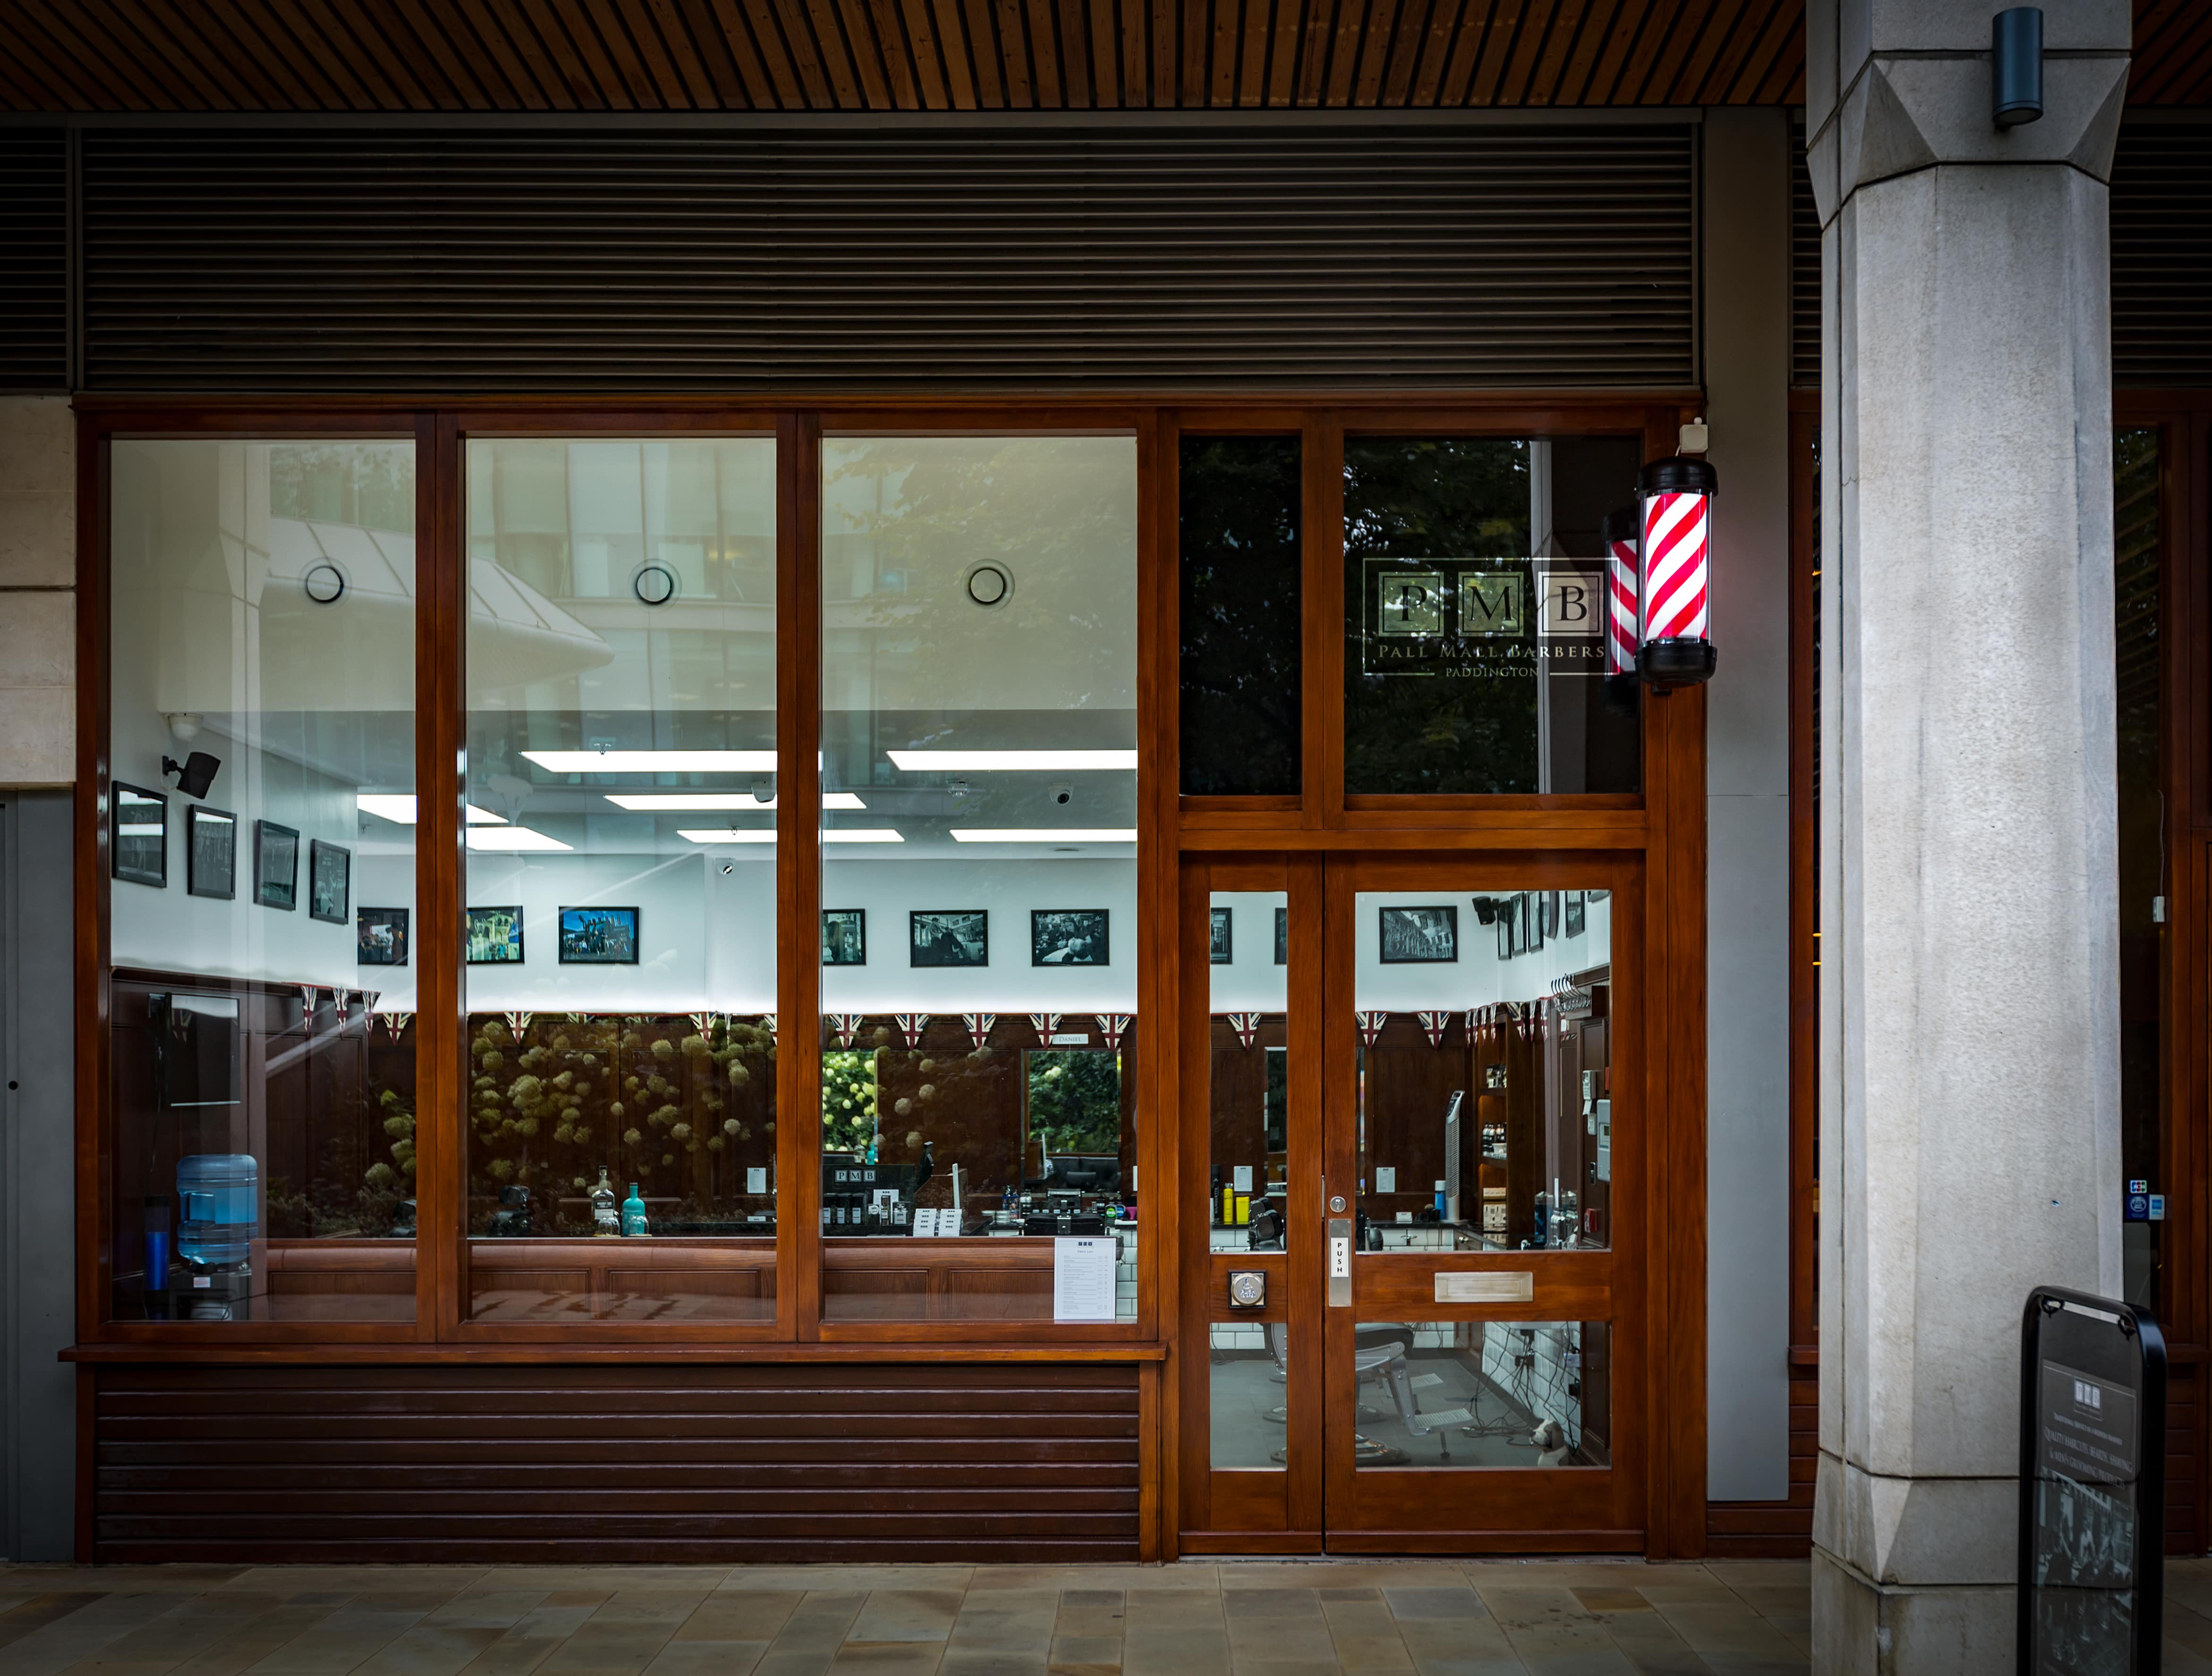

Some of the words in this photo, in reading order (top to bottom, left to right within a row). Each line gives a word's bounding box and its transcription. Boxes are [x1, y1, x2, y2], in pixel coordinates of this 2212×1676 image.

[1398, 585, 1427, 621] P
[1466, 585, 1513, 621] M
[1555, 585, 1587, 621] B
[1378, 645, 1428, 658] PALL
[1440, 644, 1497, 658] MALL
[1510, 645, 1604, 658] BARBERS
[1446, 667, 1539, 677] PADDINGTON
